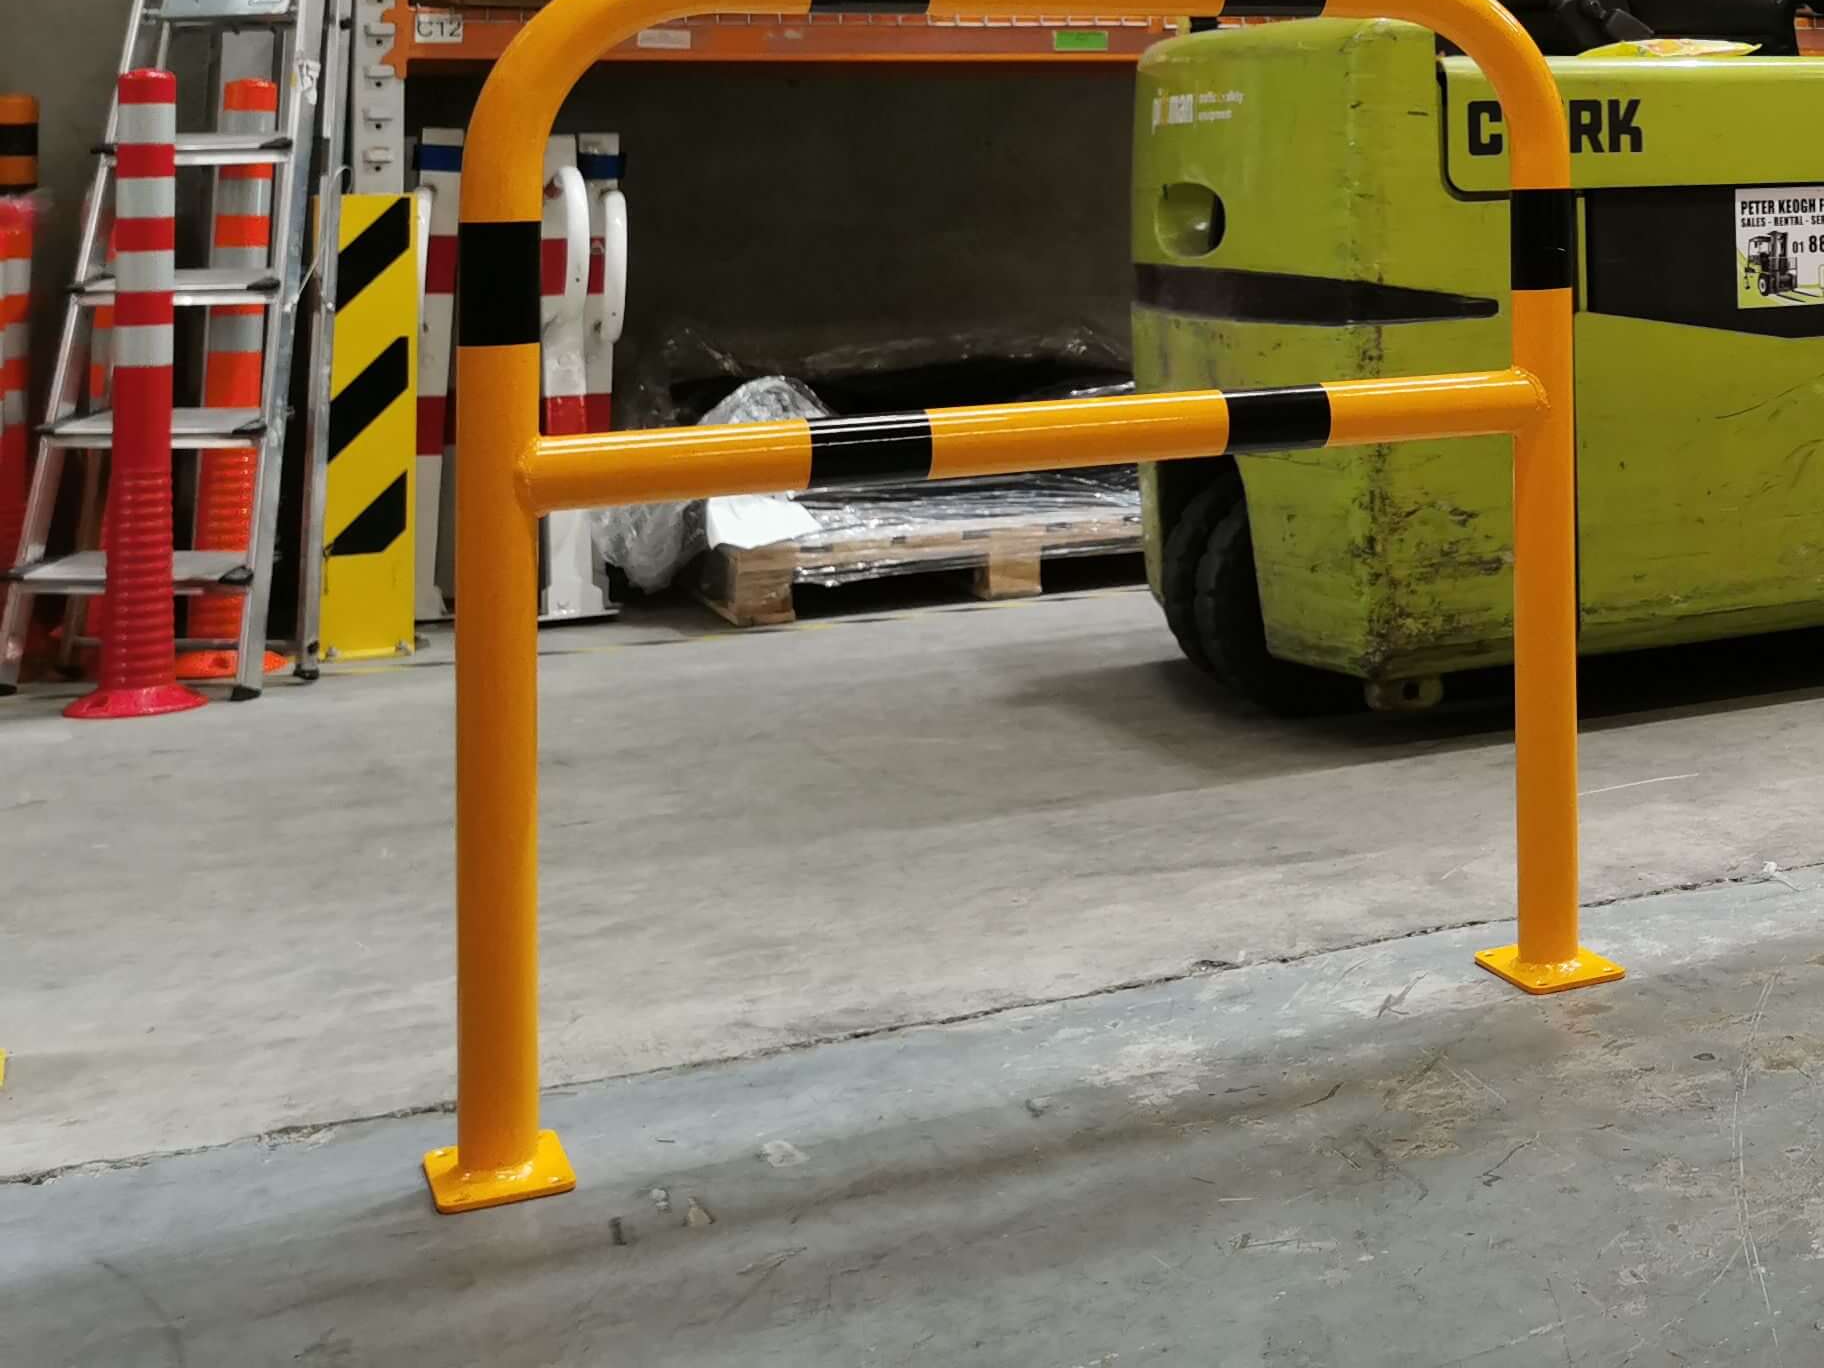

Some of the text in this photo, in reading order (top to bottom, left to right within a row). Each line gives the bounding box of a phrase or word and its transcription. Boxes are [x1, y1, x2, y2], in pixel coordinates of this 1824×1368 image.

[416, 15, 461, 38] C12
[1467, 98, 1643, 156] CRK
[1740, 199, 1775, 216] PETER
[1778, 198, 1816, 214] KEOGH
[1740, 216, 1767, 228] SALES
[1773, 215, 1804, 227] RENTAL
[1792, 241, 1804, 254] 01
